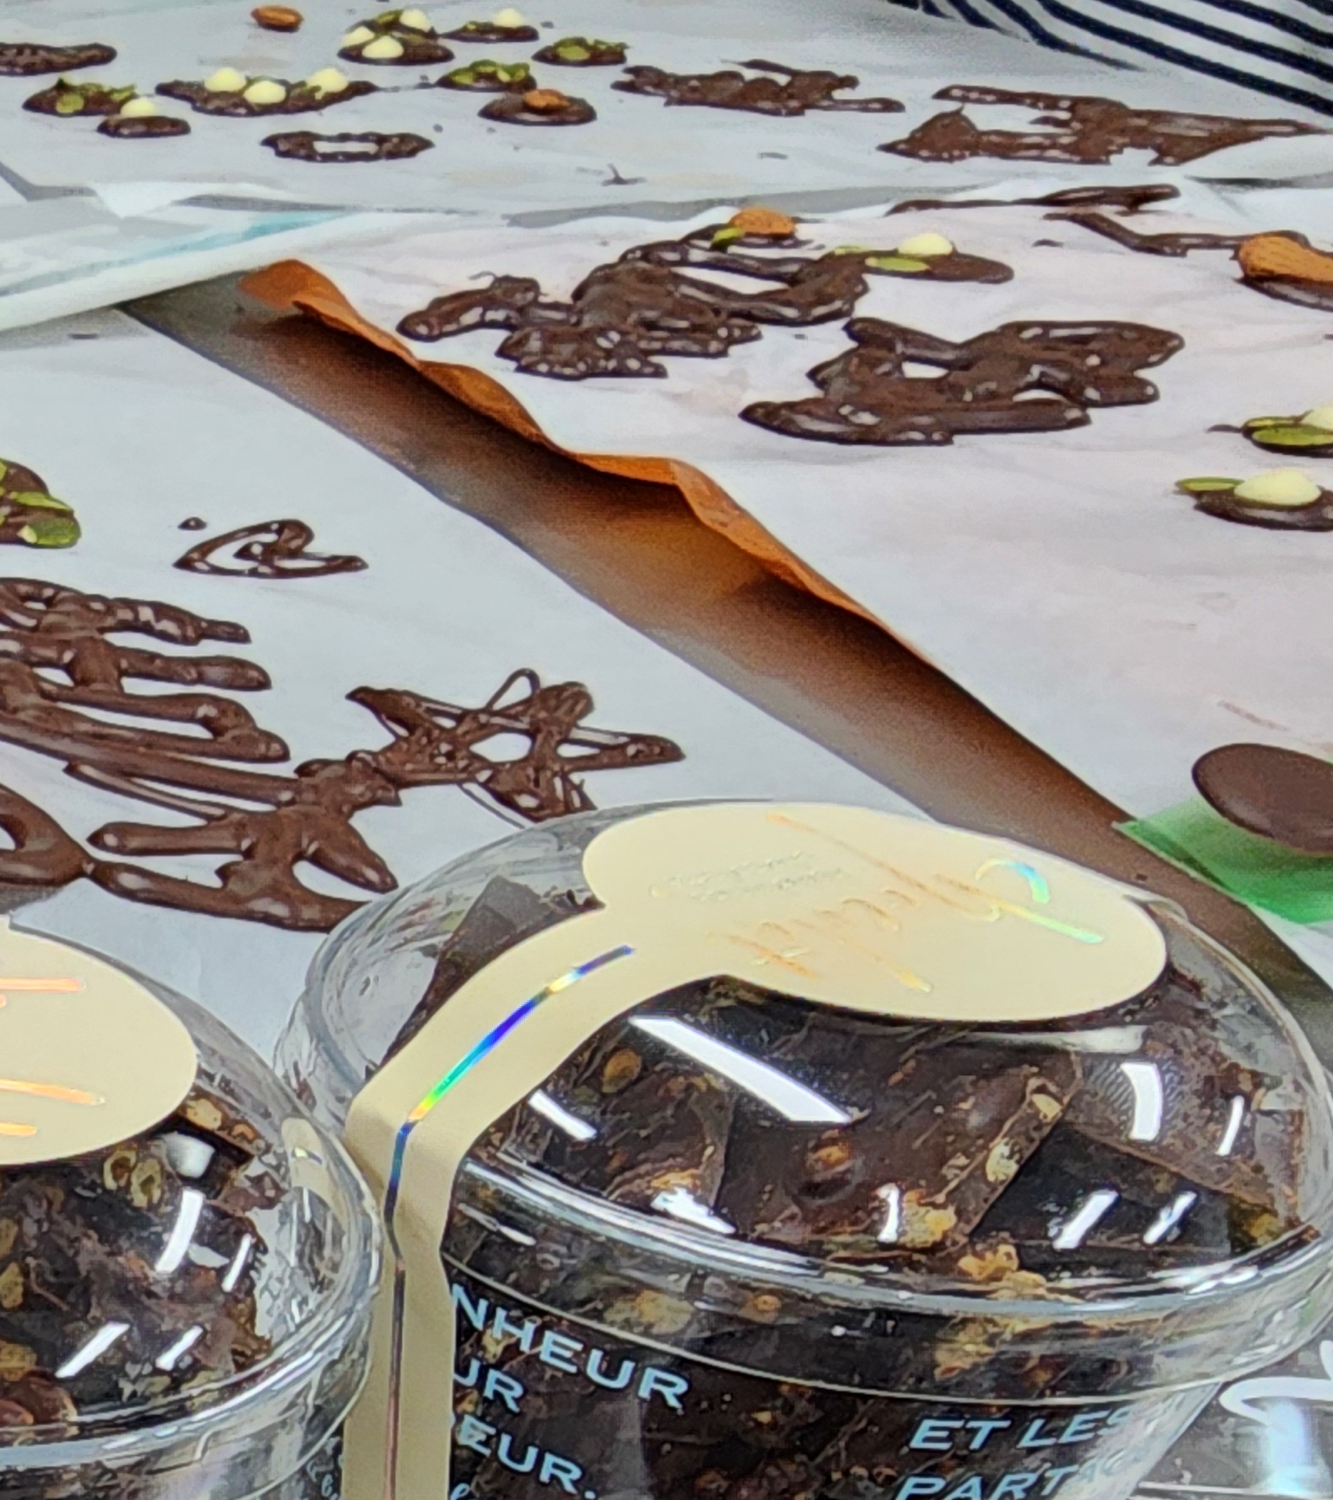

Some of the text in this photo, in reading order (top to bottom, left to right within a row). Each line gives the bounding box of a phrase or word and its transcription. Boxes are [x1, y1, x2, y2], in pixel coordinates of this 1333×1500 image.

[452, 1283, 689, 1410] NHEUR
[451, 1413, 596, 1500] EUR.
[909, 1418, 1012, 1450] ET
